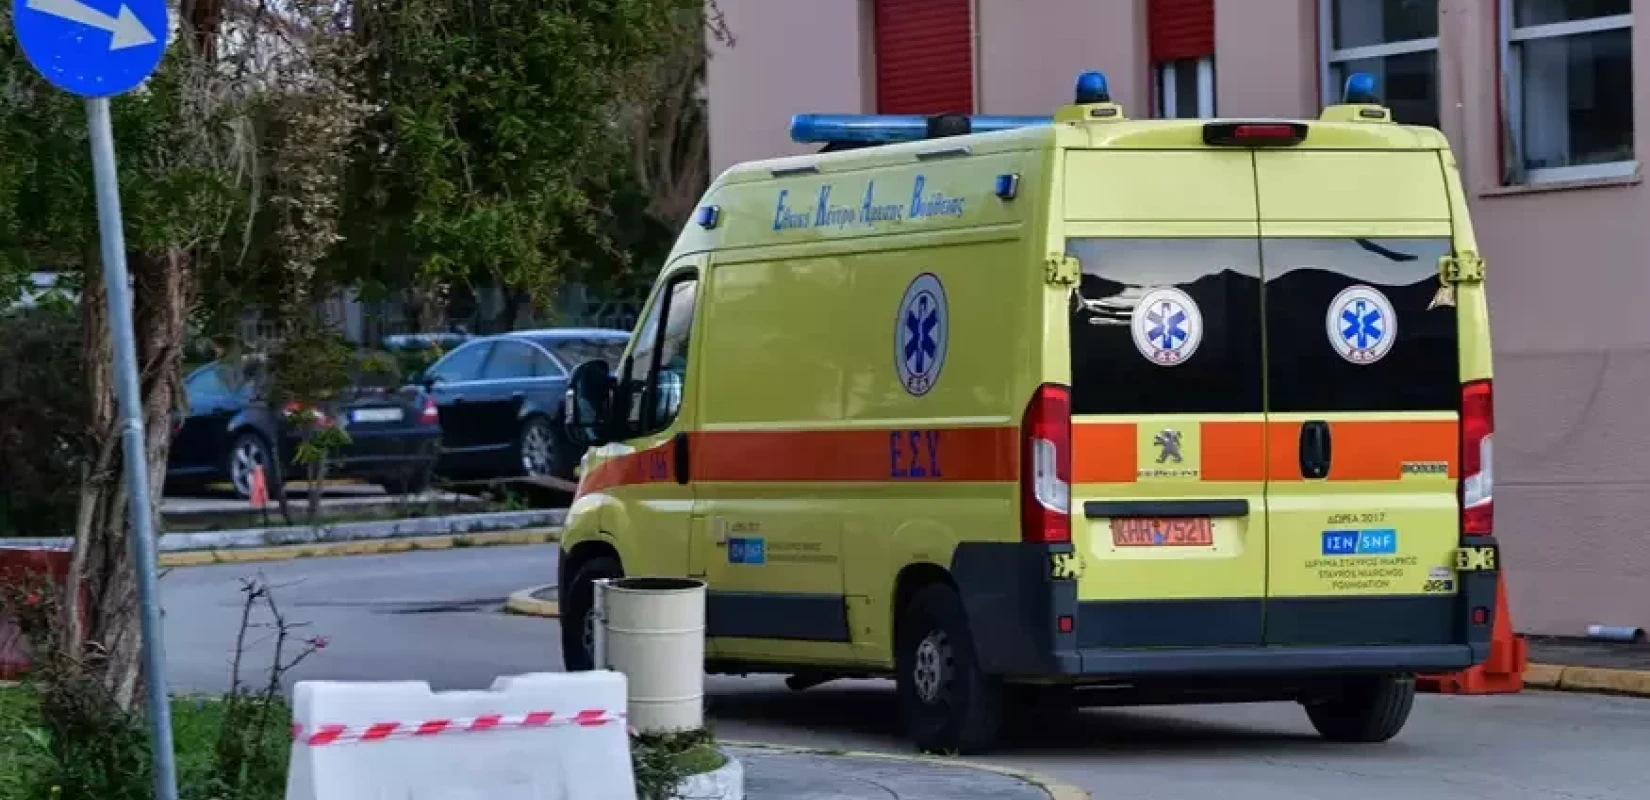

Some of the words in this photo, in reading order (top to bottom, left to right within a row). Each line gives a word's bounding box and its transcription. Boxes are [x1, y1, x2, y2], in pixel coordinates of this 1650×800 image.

[889, 430, 942, 478] ΕΣΥ
[1361, 511, 1386, 523] 2017
[1161, 518, 1209, 542] 7521
